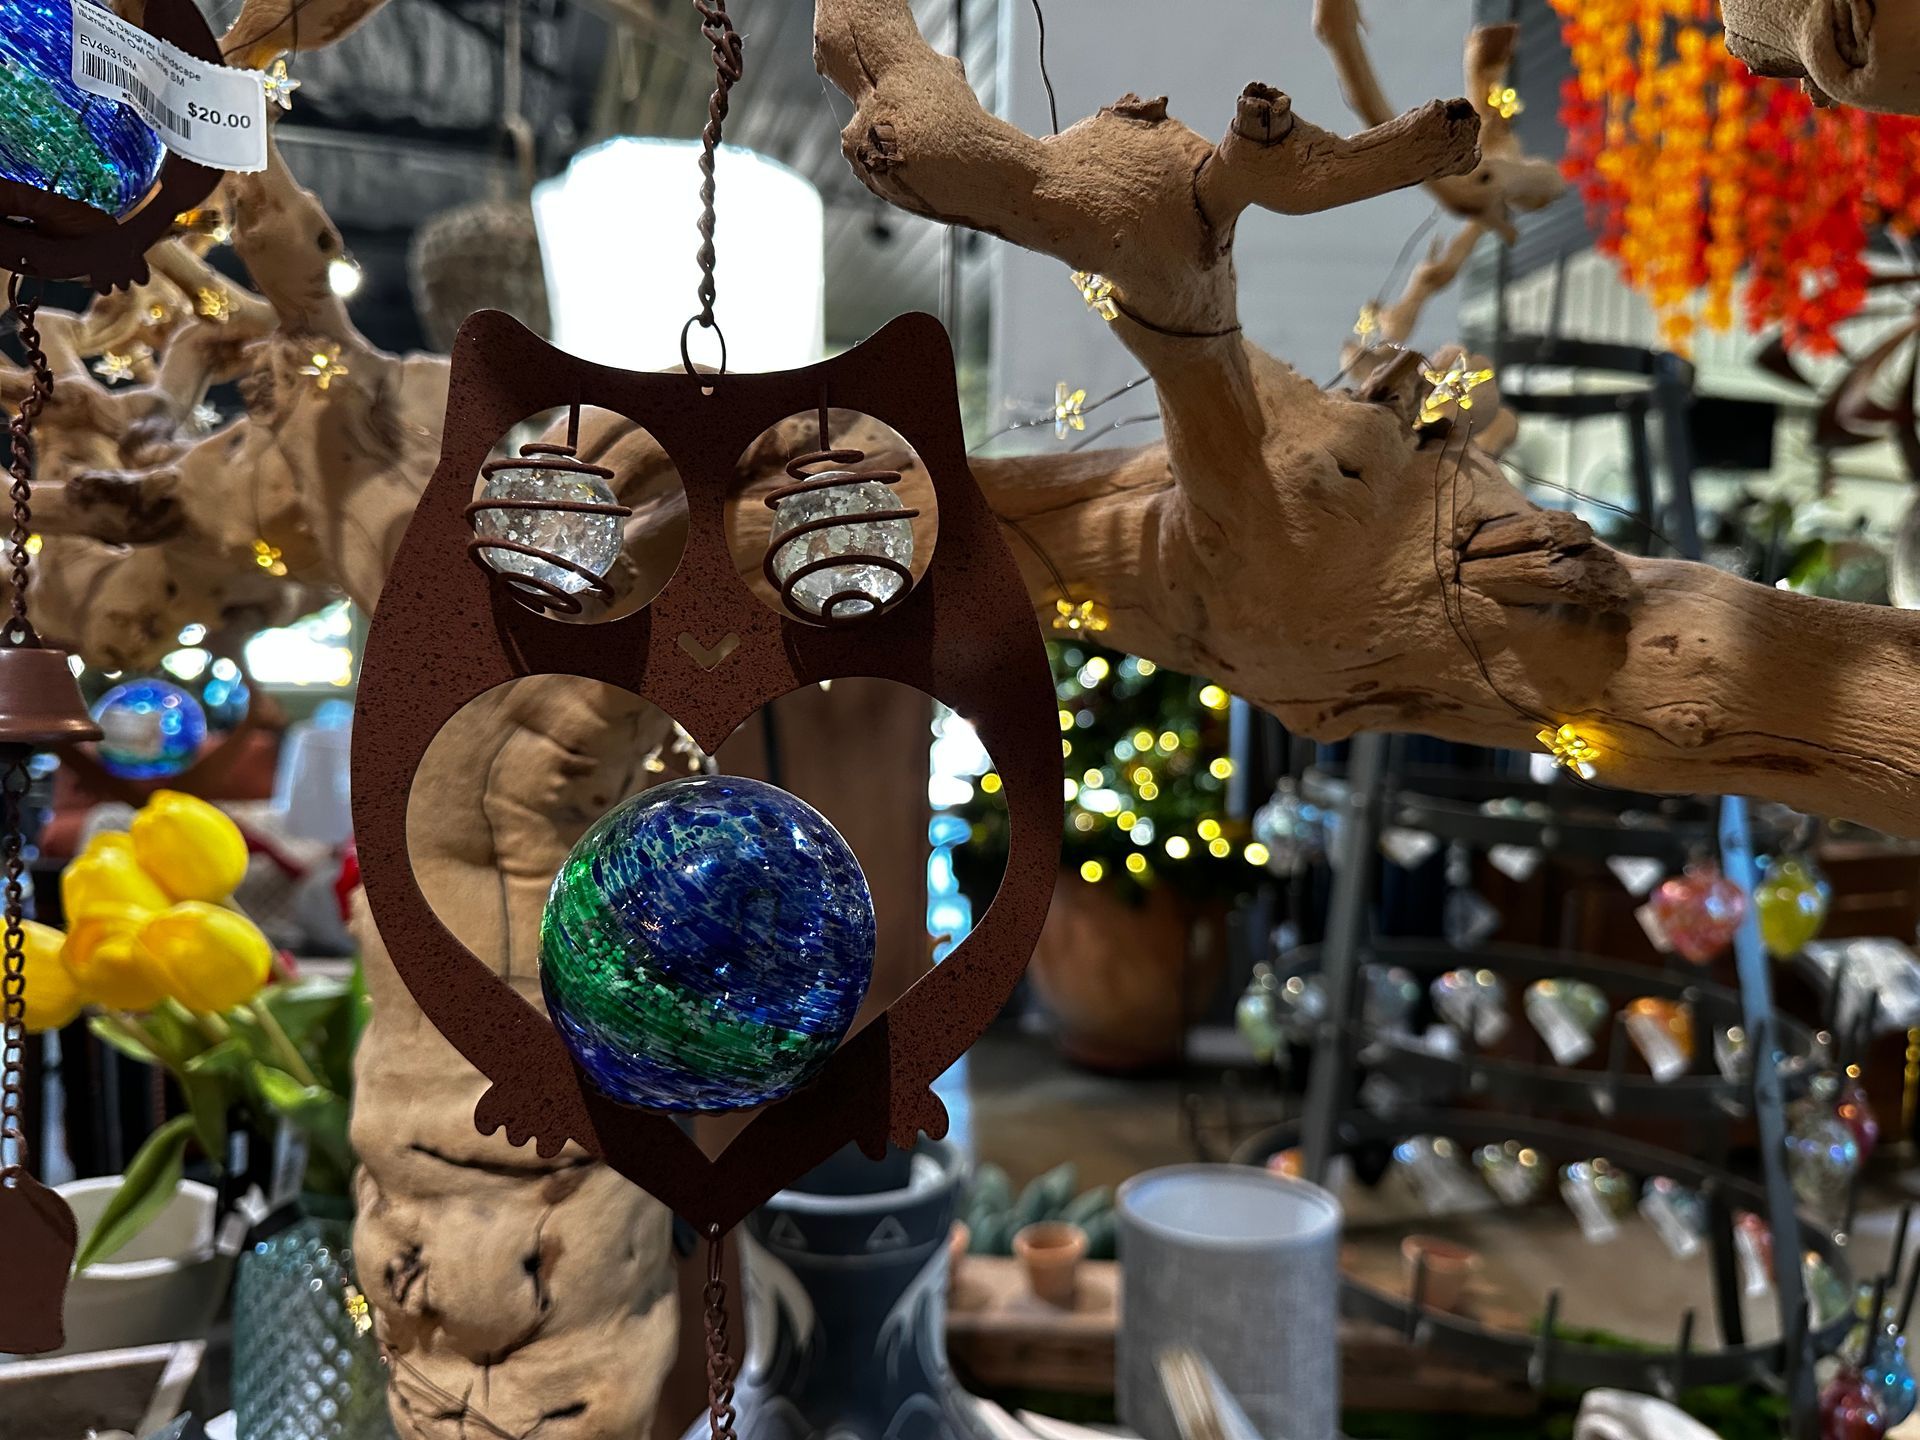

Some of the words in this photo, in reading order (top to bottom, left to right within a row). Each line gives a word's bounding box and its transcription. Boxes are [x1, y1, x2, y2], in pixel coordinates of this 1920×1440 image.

[80, 33, 137, 71] EV4931SM
[116, 21, 156, 51] Daughter
[157, 46, 201, 82] Landscape
[127, 39, 145, 55] Owl
[146, 51, 169, 76] Chime
[170, 72, 185, 87] SM
[188, 102, 251, 129] $20.00
